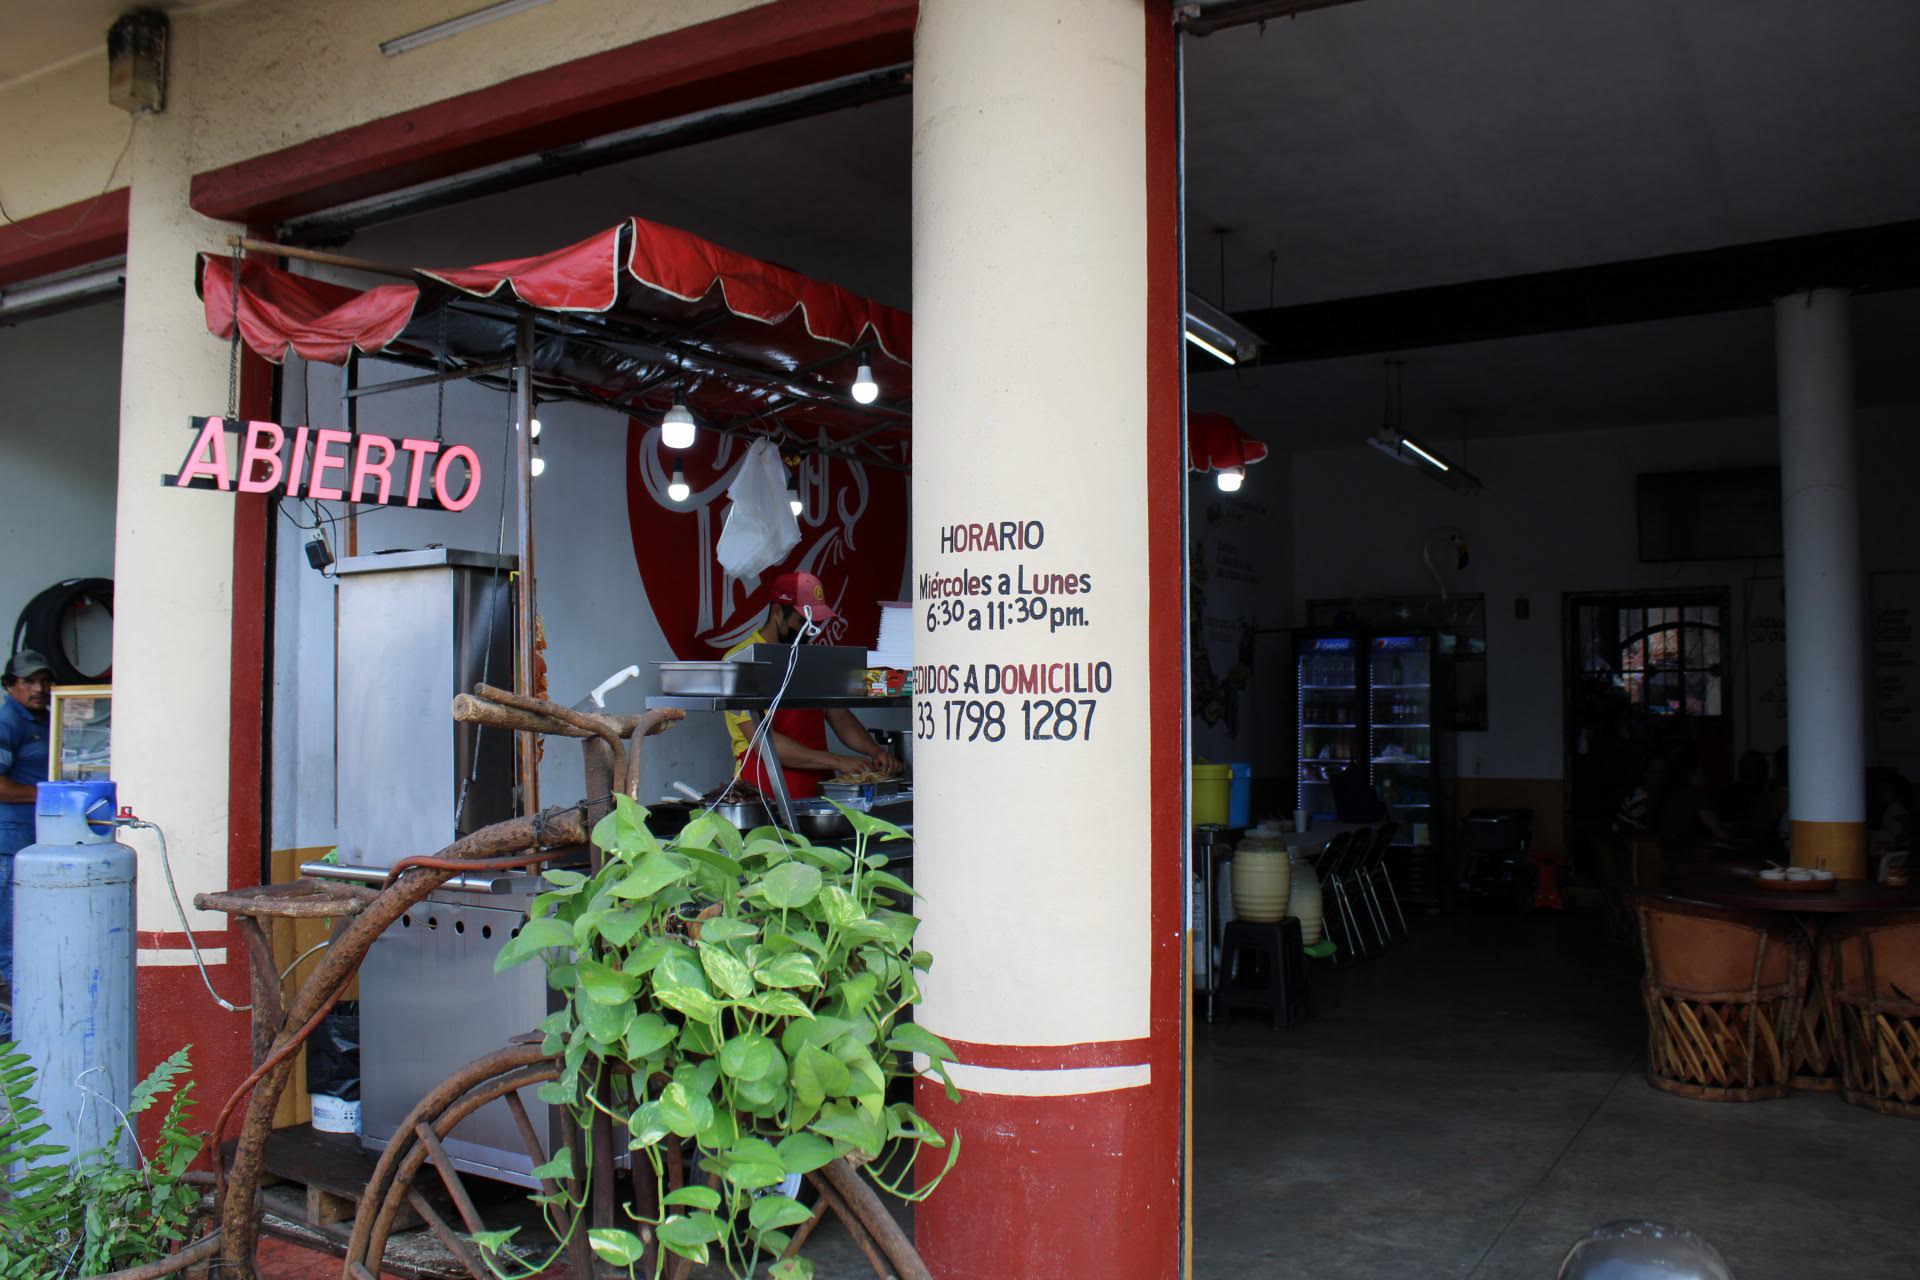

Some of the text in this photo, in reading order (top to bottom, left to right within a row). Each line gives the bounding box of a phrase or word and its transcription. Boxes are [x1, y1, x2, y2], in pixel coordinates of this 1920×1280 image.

[177, 416, 481, 512] ABIERTO
[941, 520, 1044, 554] HORARIO
[919, 564, 1092, 600] Miércoles a Lunes
[926, 597, 1090, 633] 6:30 a 11:30 pm.
[963, 664, 979, 694] A
[984, 661, 1112, 695] DOMICILIO
[917, 698, 1097, 743] 33 1798 1287
